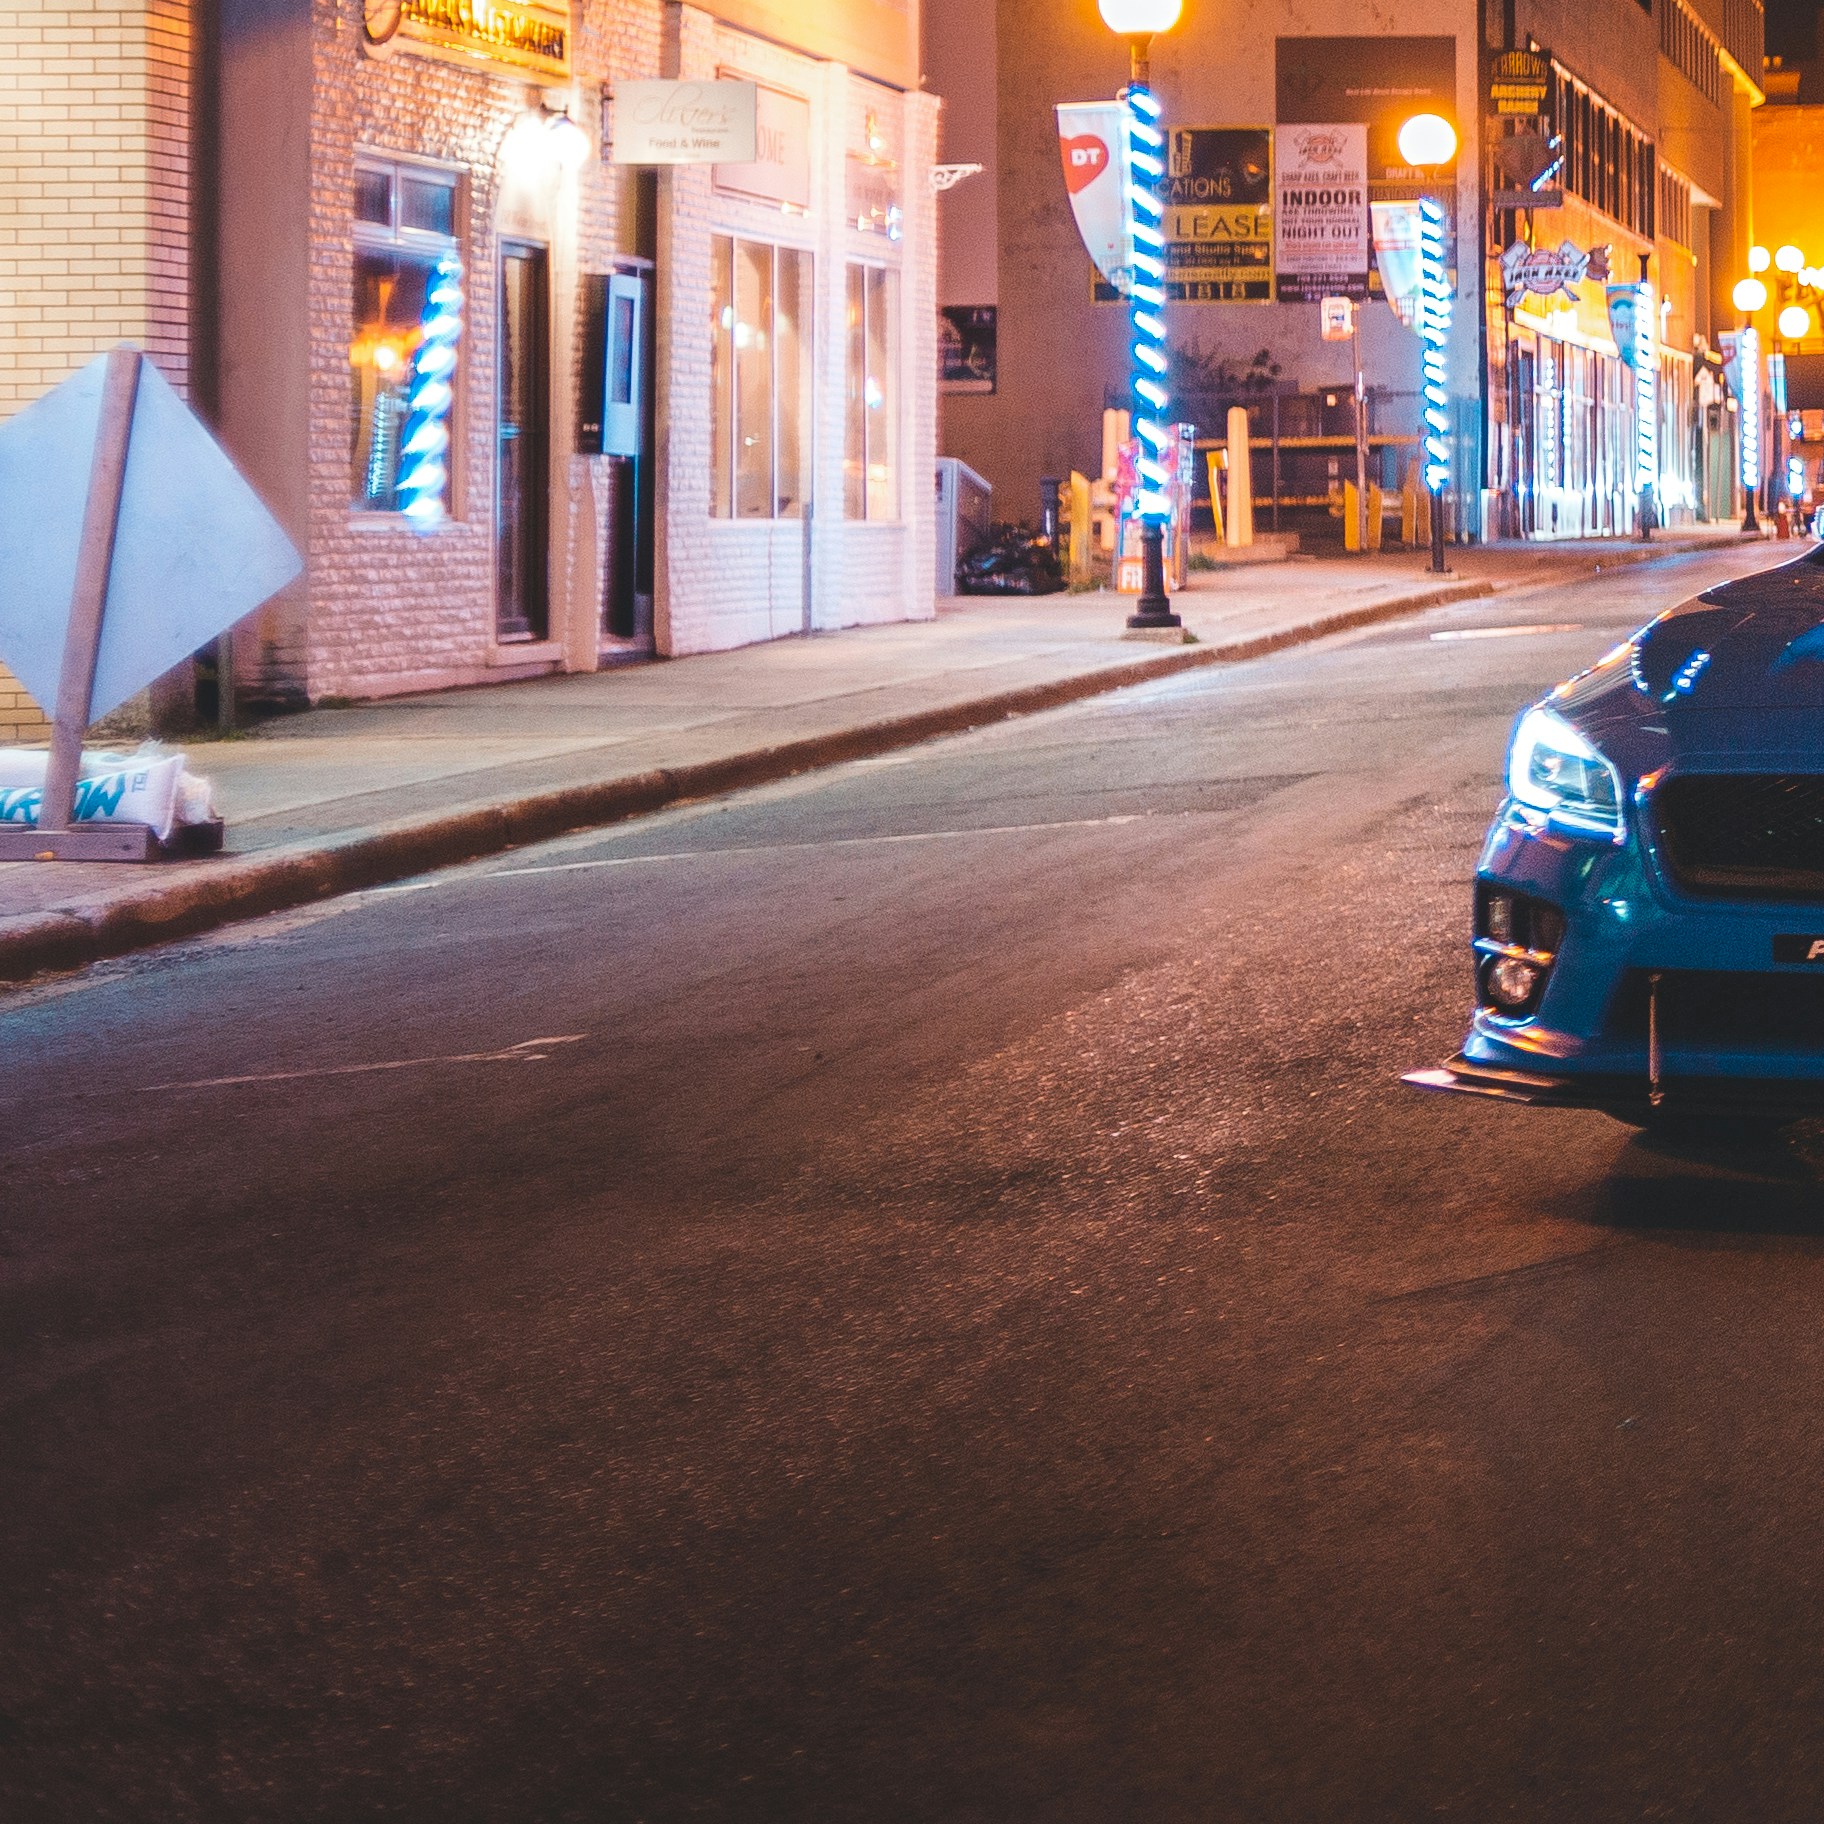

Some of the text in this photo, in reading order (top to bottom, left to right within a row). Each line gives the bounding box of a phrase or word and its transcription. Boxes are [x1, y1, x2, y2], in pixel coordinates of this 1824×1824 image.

[649, 137, 677, 149] Food
[691, 137, 720, 148] Wine
[1070, 148, 1101, 167] DT
[1282, 190, 1361, 206] INDOOR
[1176, 214, 1269, 239] LEASE
[1282, 227, 1359, 239] NIGHT OUT
